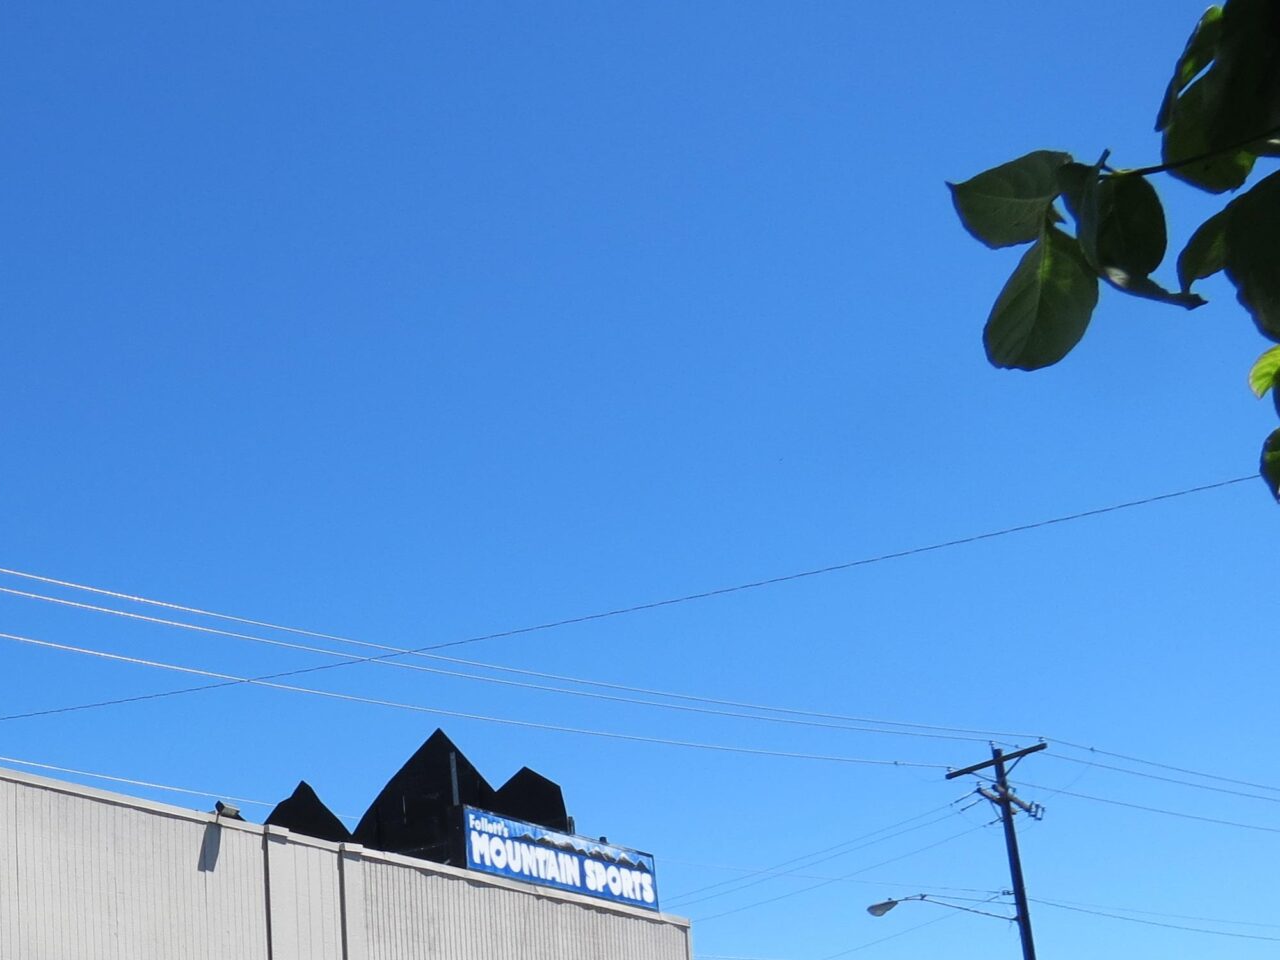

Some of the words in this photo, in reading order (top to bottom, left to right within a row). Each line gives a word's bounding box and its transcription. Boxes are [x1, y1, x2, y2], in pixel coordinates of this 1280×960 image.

[468, 813, 509, 838] Follett's
[471, 830, 581, 888] MOUNTAIN
[583, 858, 655, 904] SPORTS
